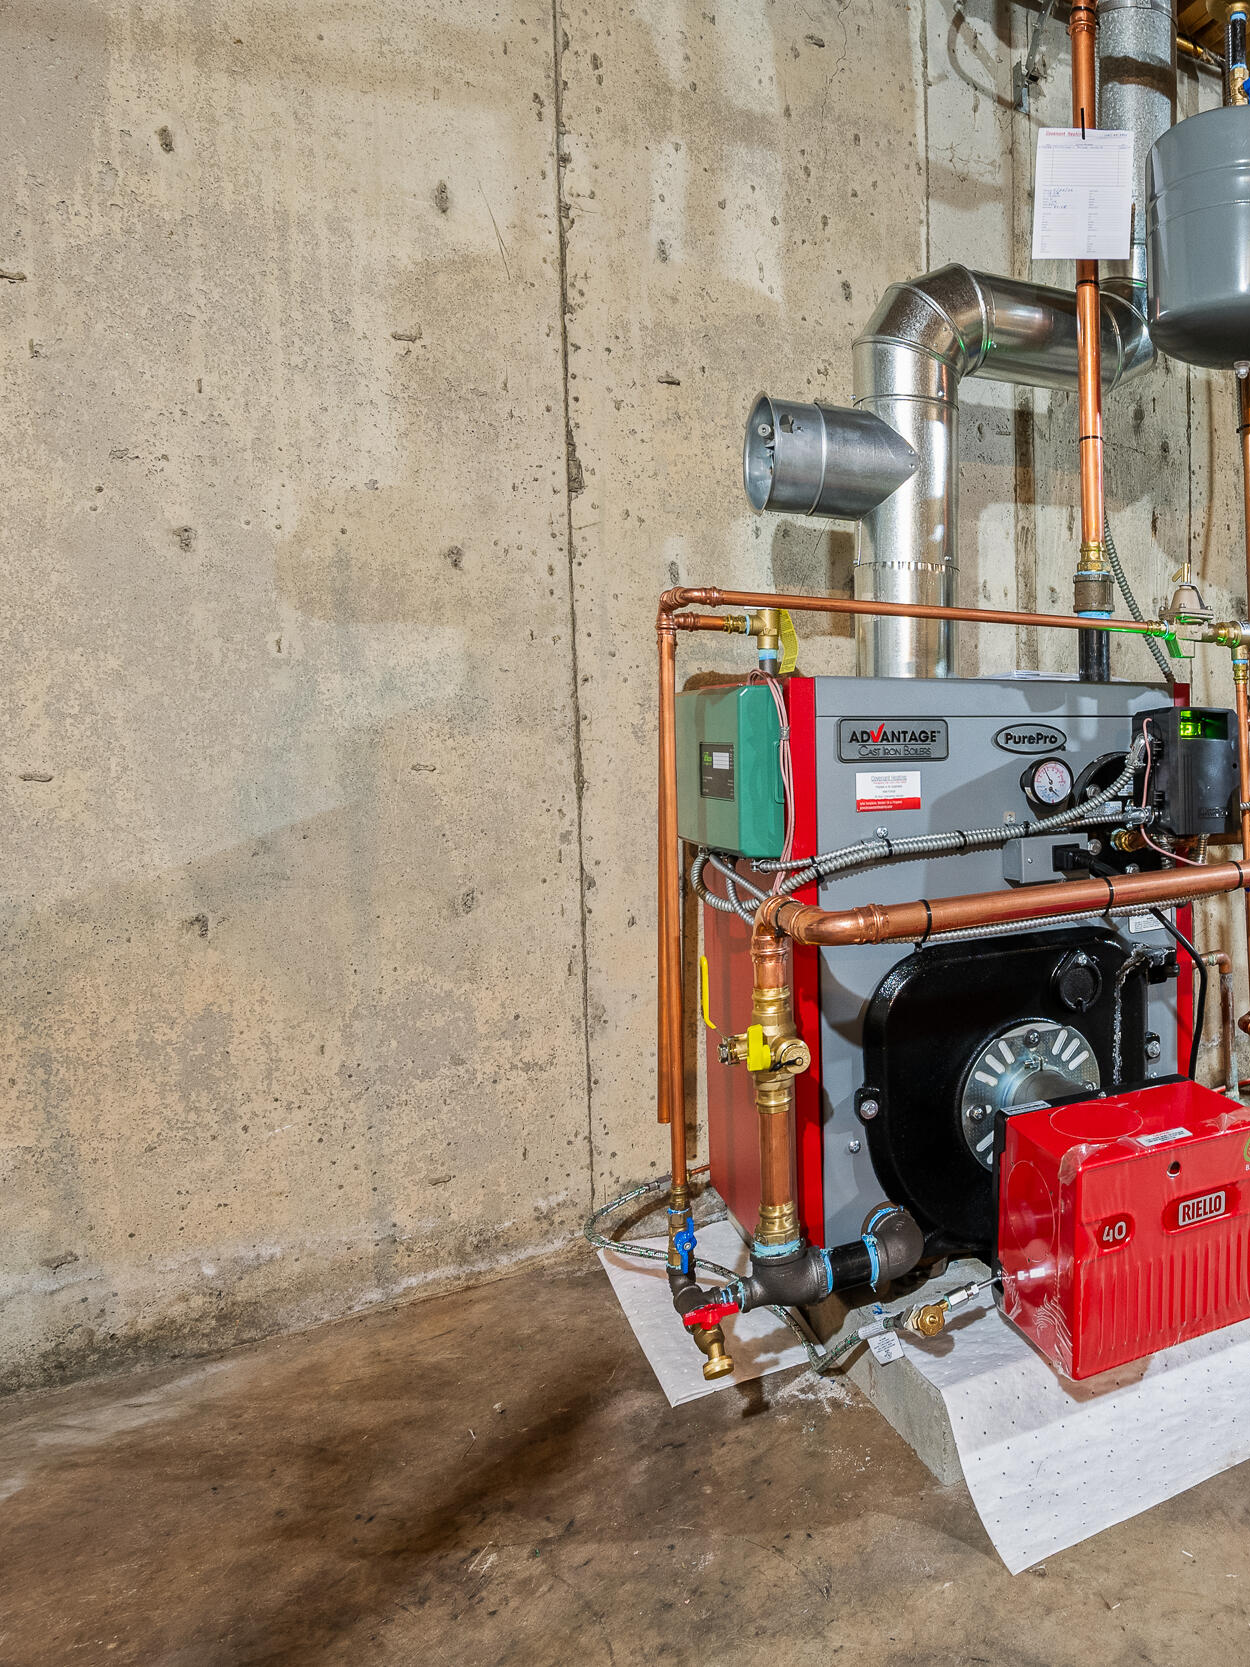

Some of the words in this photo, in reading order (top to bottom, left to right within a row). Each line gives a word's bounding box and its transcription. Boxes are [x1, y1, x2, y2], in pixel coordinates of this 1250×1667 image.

[848, 722, 937, 744] ADVANTAGE
[1004, 732, 1058, 745] PurePro
[1181, 1194, 1222, 1222] RIELLO
[1102, 1221, 1127, 1243] 40
